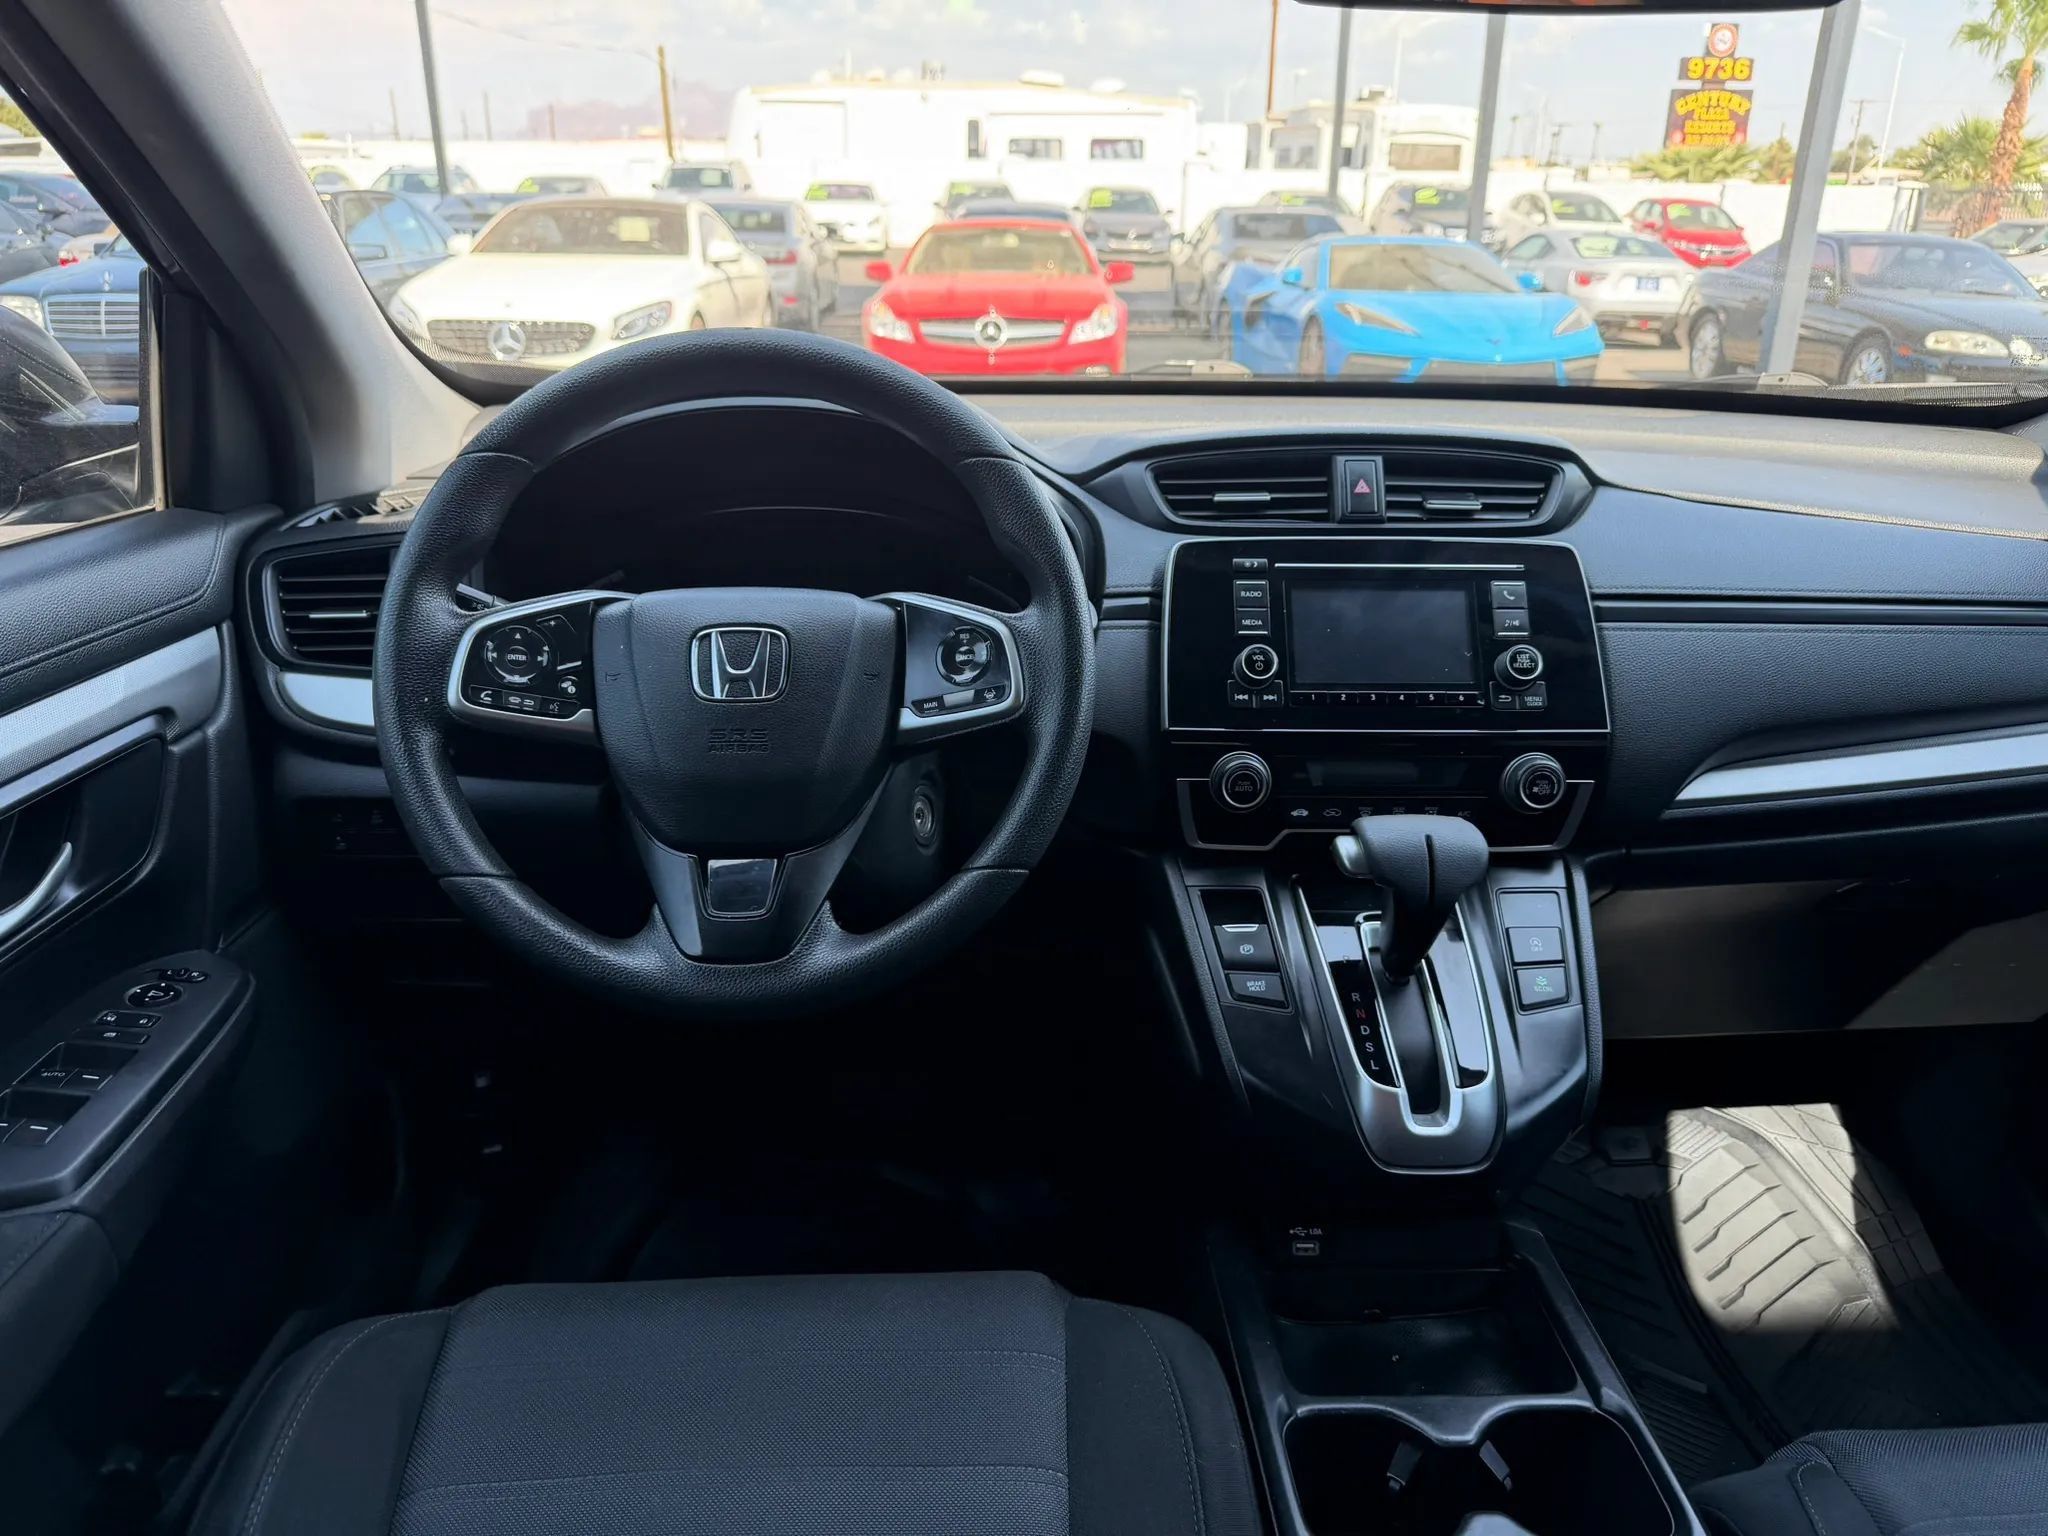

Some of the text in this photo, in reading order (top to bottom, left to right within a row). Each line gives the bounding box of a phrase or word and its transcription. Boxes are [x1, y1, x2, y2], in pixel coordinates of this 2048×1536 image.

[1688, 57, 1750, 79] 9736
[1240, 590, 1262, 598] RADIO
[923, 701, 938, 709] MAIN
[709, 729, 769, 741] SRS
[1352, 992, 1361, 1002] R
[1356, 1008, 1366, 1018] N
[1361, 1025, 1370, 1035] D
[1365, 1042, 1375, 1052] S
[1371, 1060, 1379, 1070] L
